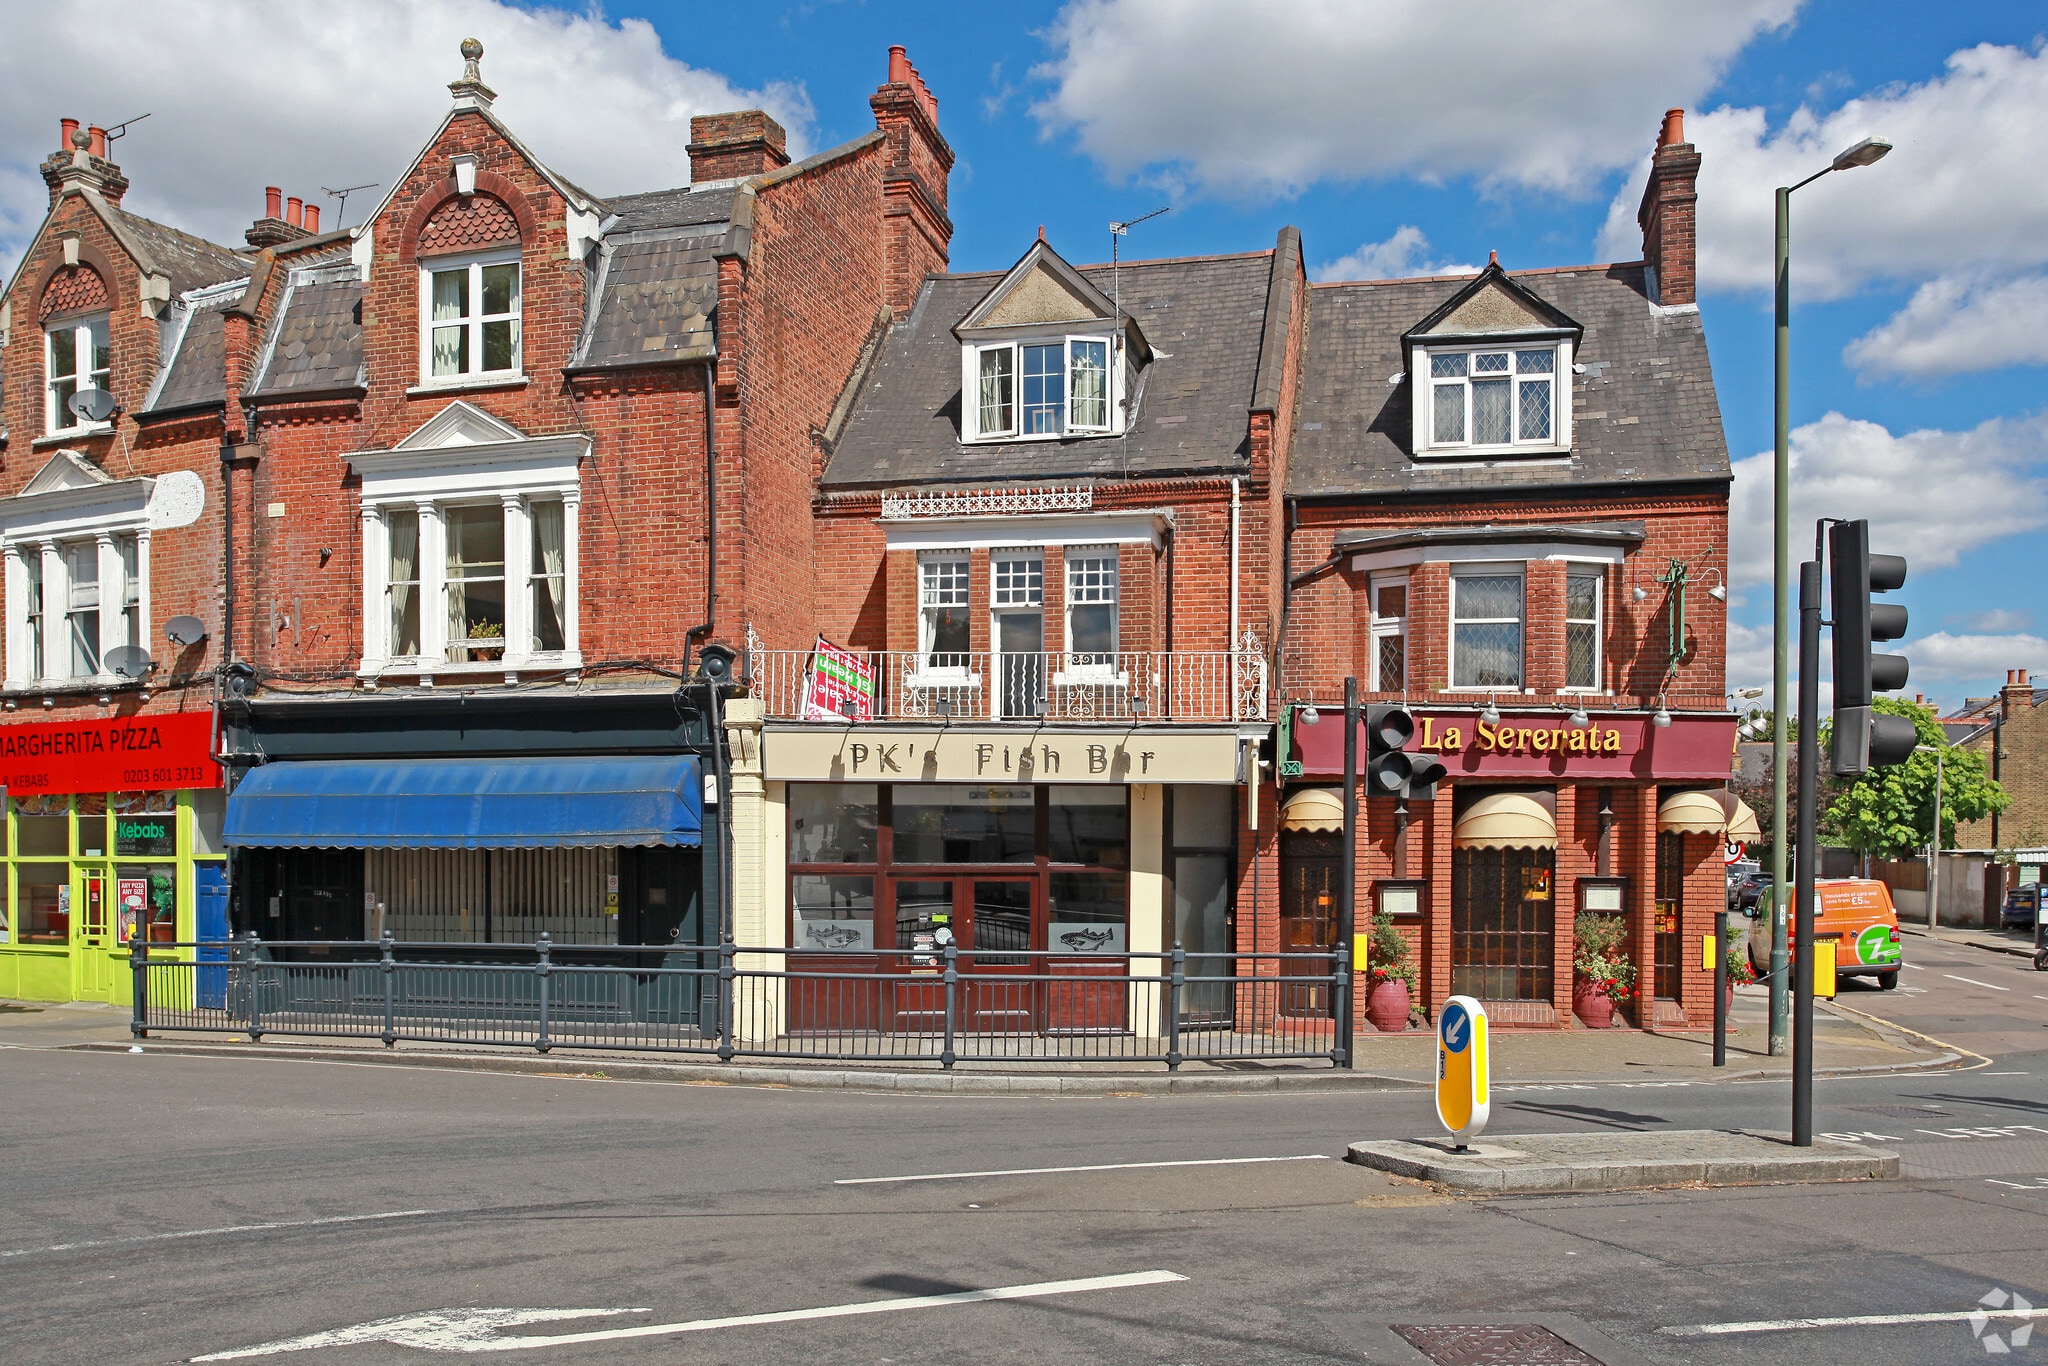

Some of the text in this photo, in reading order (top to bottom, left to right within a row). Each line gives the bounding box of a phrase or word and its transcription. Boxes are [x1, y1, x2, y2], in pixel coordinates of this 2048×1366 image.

[110, 726, 162, 751] PIZZA
[1421, 717, 1621, 756] La Serenata
[849, 743, 1154, 775] PK's Fish Bar
[14, 774, 49, 788] KEBABS
[124, 766, 203, 783] 0203 601 3713
[119, 821, 165, 838] Kebabs
[1913, 1126, 2048, 1138] LEFT
